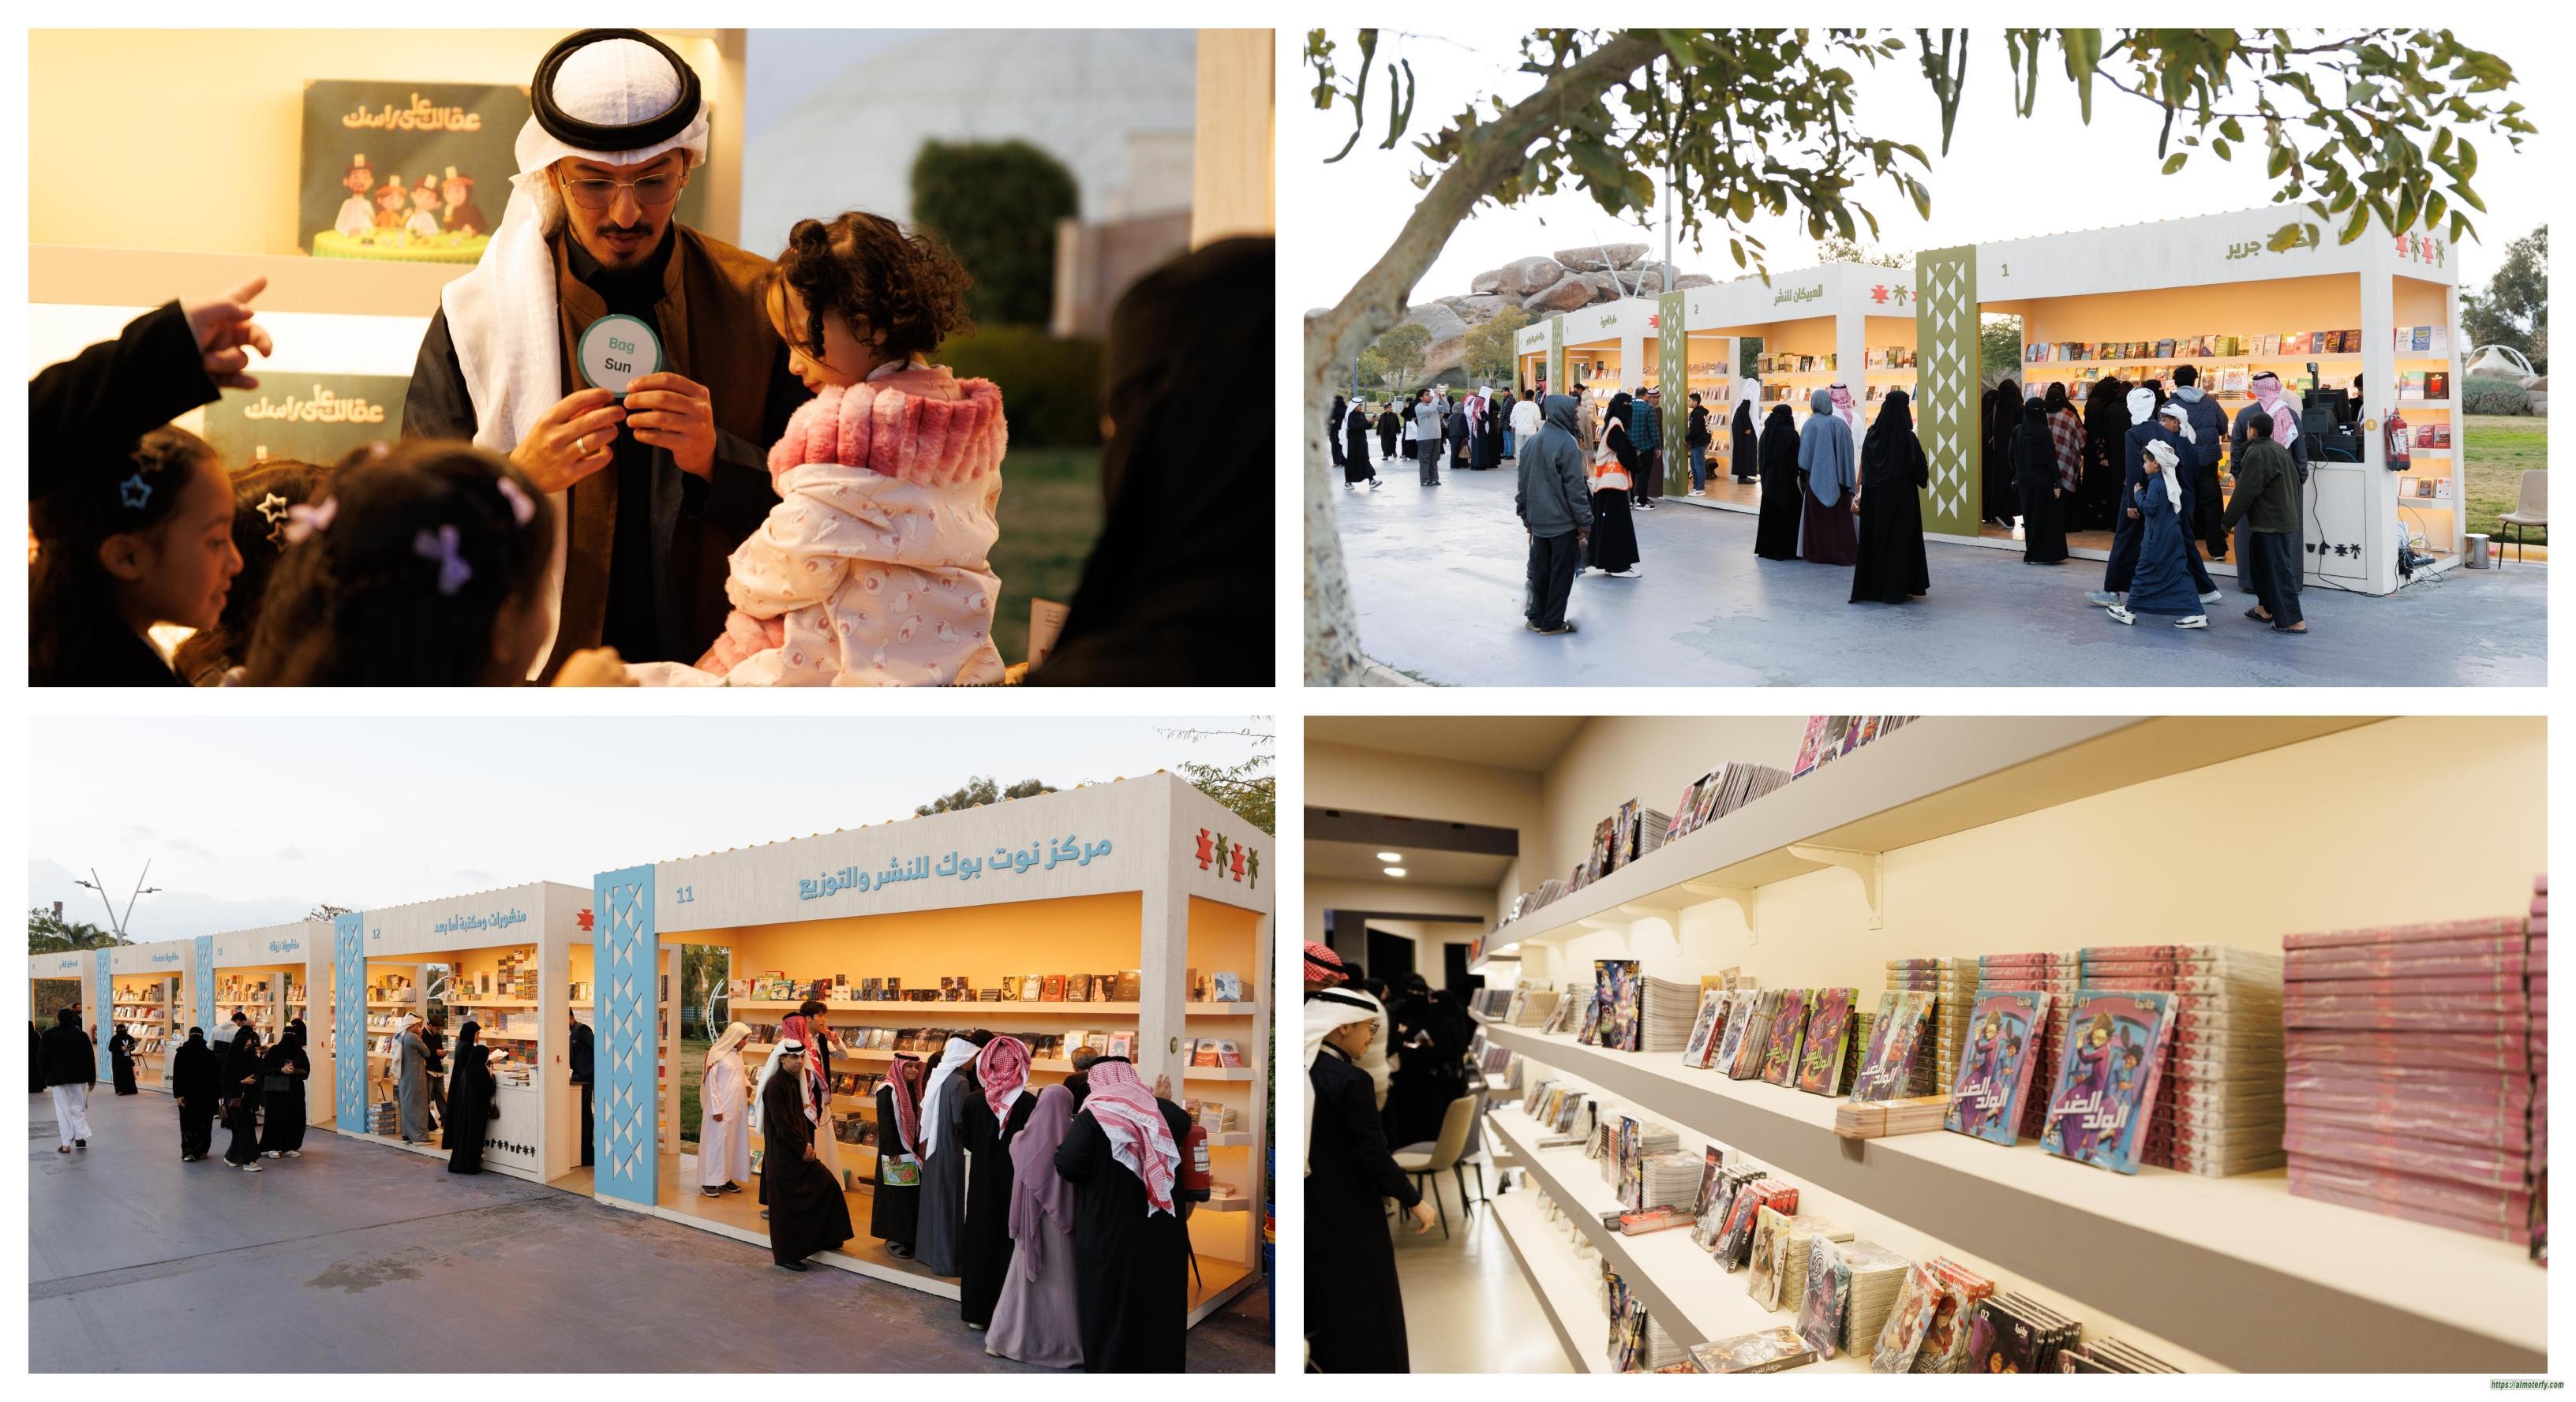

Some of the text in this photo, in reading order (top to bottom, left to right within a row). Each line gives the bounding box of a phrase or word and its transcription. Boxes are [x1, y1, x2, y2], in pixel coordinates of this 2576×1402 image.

[2226, 241, 2261, 260] جرير
[2001, 264, 2009, 277] 1
[1774, 284, 1822, 307] العبيكان للنشر
[1694, 304, 1698, 315] 2
[608, 337, 635, 355] Bag
[605, 357, 631, 374] Sun
[799, 834, 1112, 900] مركز نوت بوك للنشر والتوزيع
[677, 885, 694, 903] 11
[434, 907, 526, 935] منشورات ومكتبة أما بعد
[373, 928, 380, 939] 12
[1977, 996, 1986, 1007] 01
[2078, 996, 2090, 1008] 01
[1861, 1060, 1897, 1088] الولد الضب
[1956, 1076, 2009, 1110] الولد الضب
[2054, 1092, 2129, 1134] الولد الضب
[1980, 1309, 1990, 1322] 02
[2063, 1363, 2076, 1374] 01
